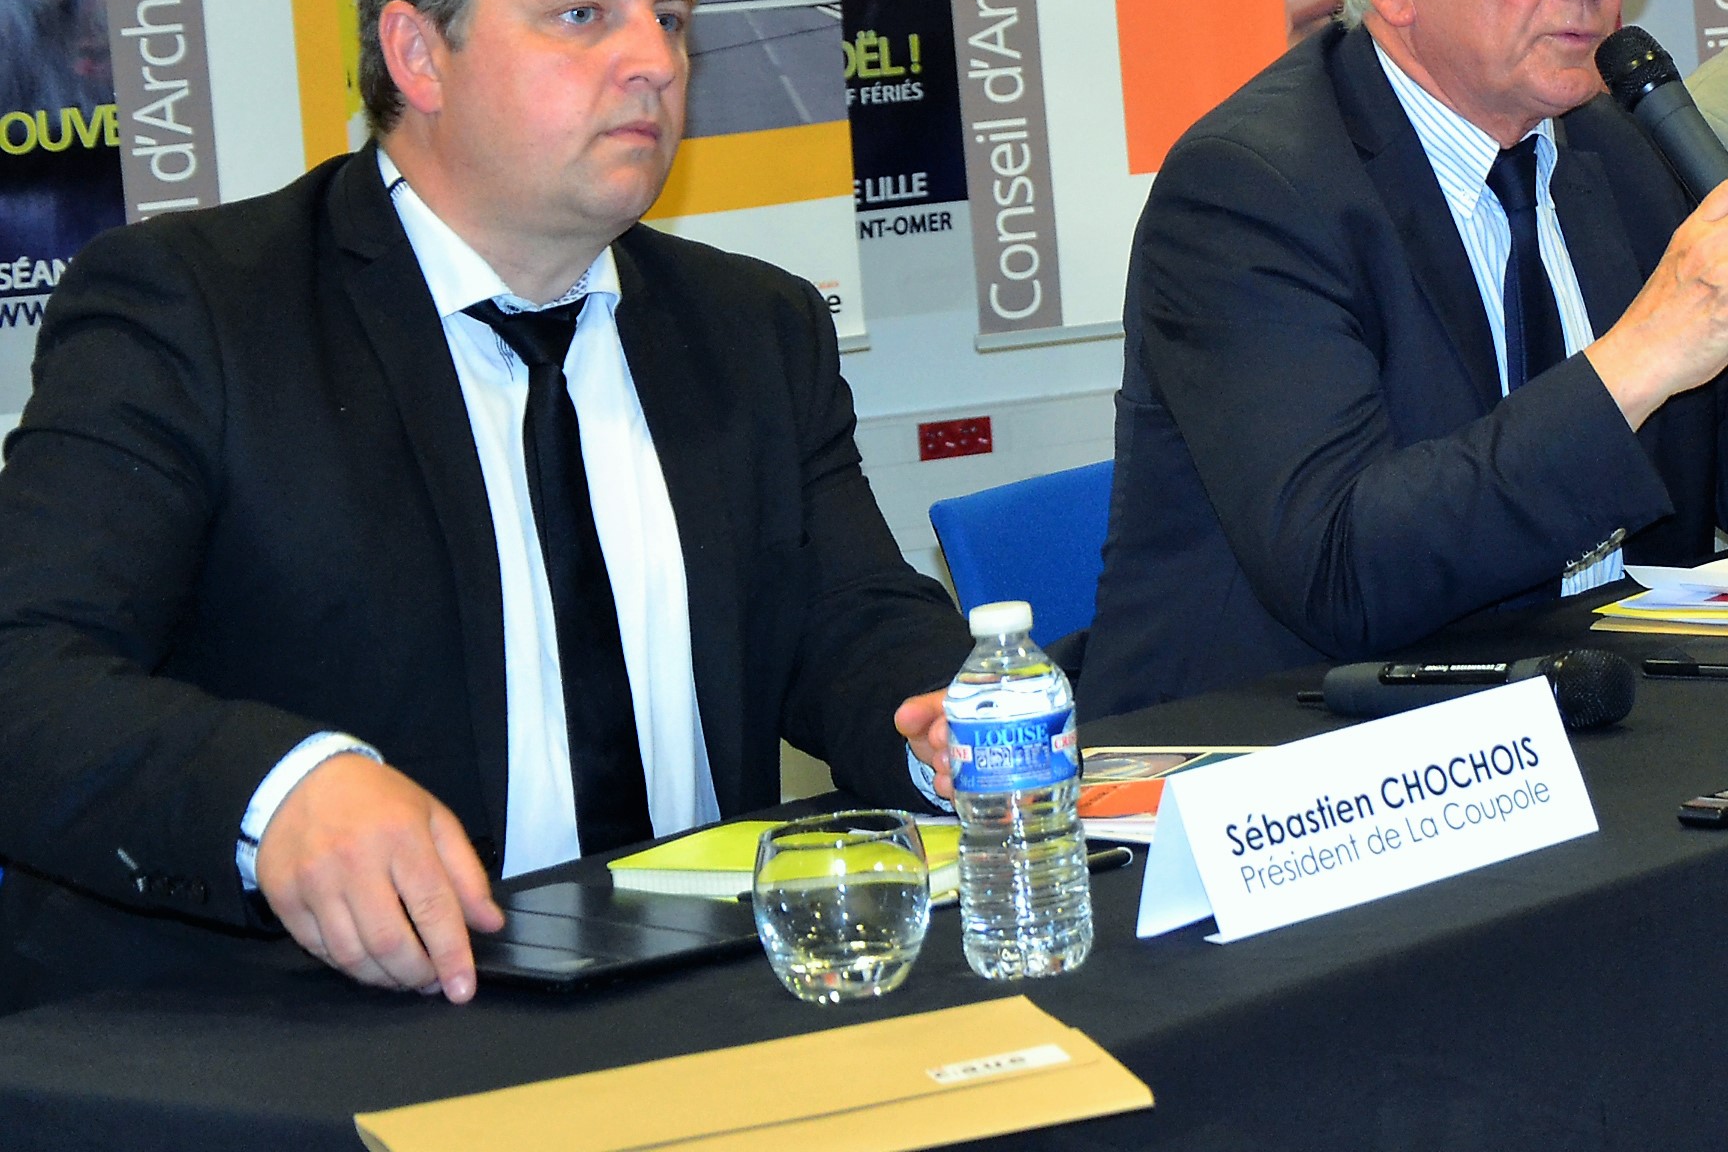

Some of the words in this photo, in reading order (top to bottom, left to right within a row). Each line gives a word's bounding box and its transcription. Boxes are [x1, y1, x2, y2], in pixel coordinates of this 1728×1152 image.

[860, 81, 924, 105] FÉRIÉS
[865, 172, 929, 203] LILLE
[973, 118, 1041, 320] Conseil
[974, 723, 1049, 747] LOUISE
[1227, 794, 1374, 856] Sébastien
[1381, 737, 1538, 808] CHOCHOIS
[1241, 835, 1359, 893] Président
[1368, 826, 1401, 854] de
[1405, 818, 1438, 842] La
[1444, 780, 1550, 830] Coupole
